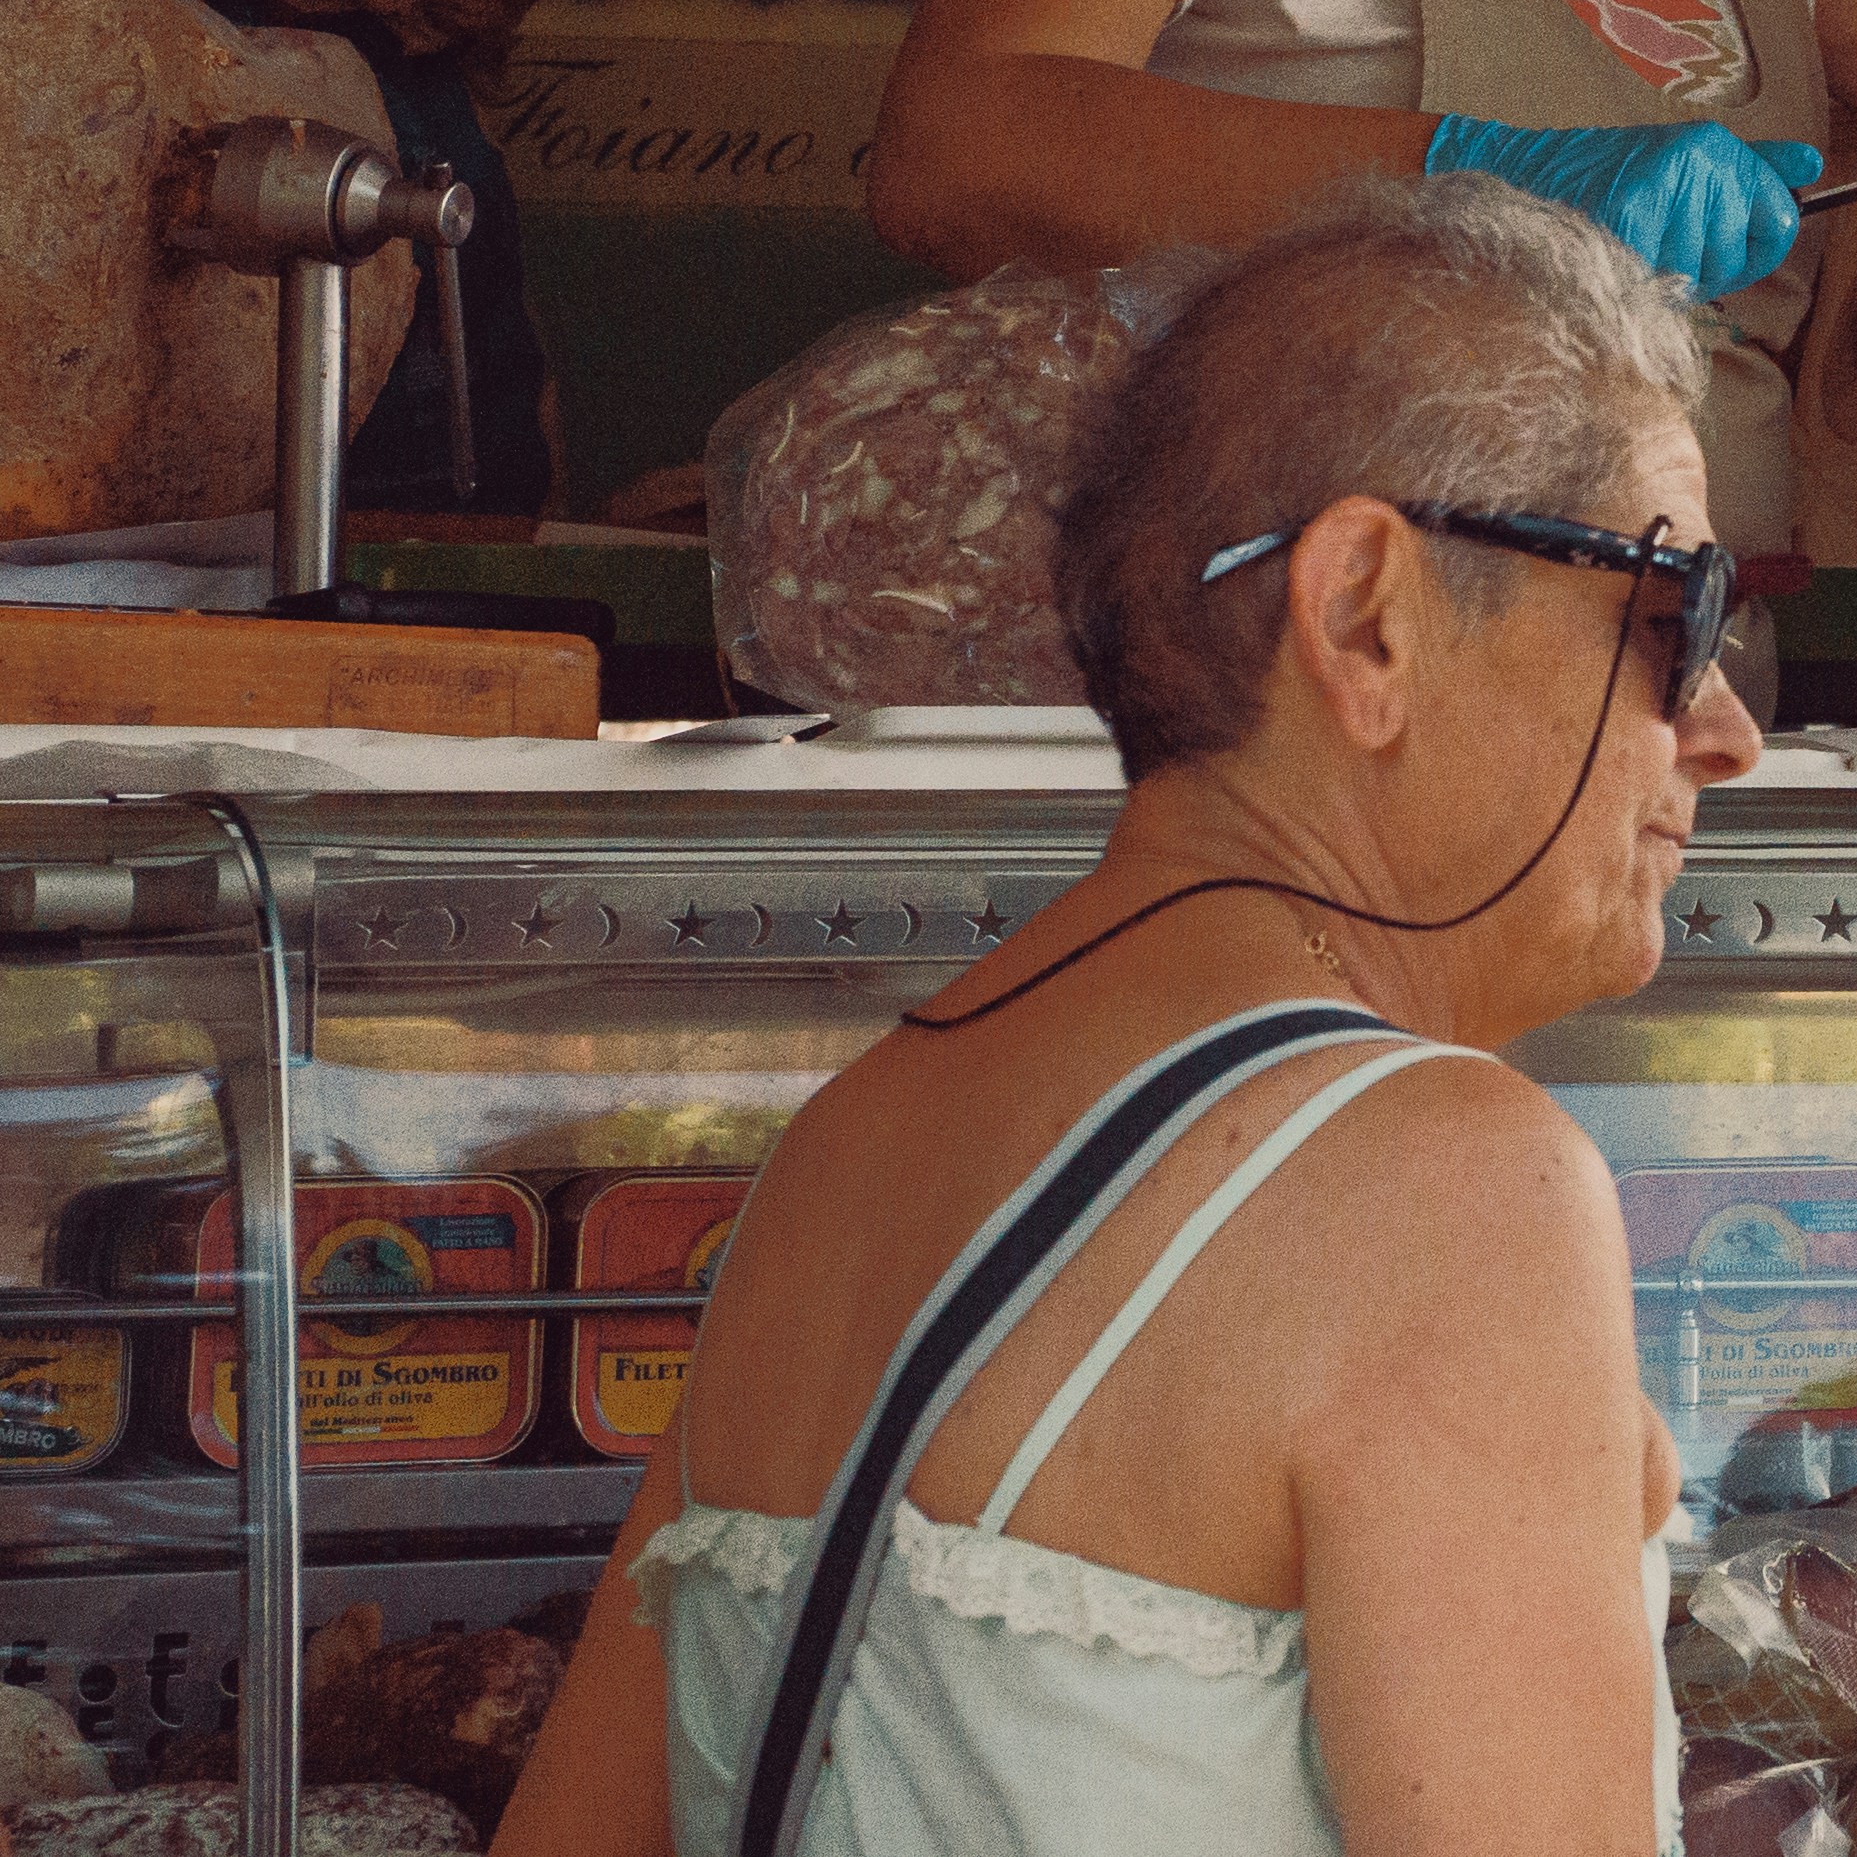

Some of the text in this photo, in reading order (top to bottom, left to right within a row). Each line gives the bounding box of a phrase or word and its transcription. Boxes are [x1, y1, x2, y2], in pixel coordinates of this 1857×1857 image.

[483, 57, 815, 177] Foiano
[336, 1371, 362, 1388] DI
[371, 1362, 499, 1387] SGOMBRO
[615, 1357, 688, 1381] FILET
[365, 1389, 381, 1406] di
[389, 1390, 433, 1405] oliva
[0, 1428, 57, 1450] MBRO
